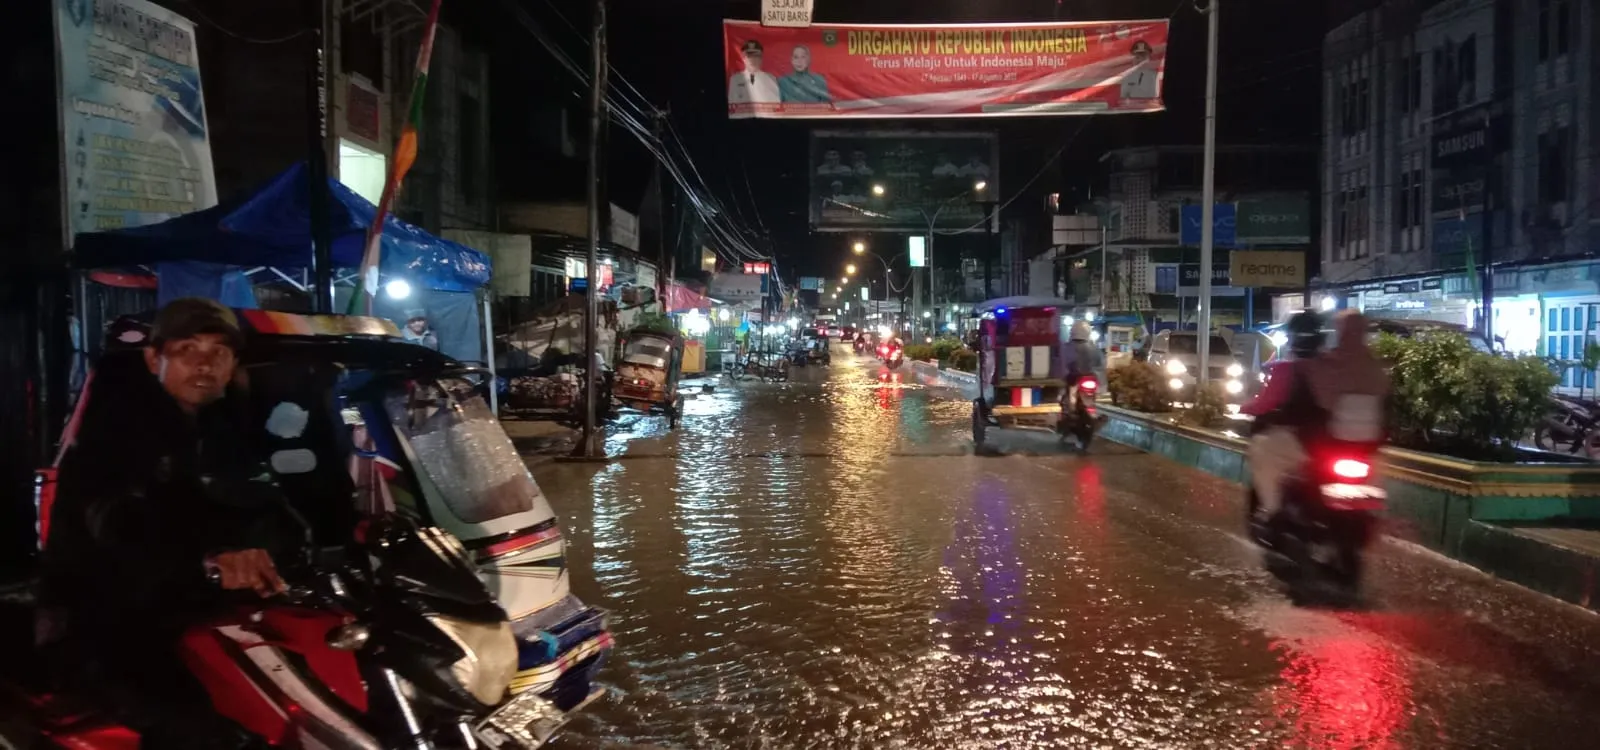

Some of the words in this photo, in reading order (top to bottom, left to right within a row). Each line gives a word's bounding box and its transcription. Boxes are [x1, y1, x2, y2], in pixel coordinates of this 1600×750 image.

[772, 0, 805, 8] SEJAJAR
[768, 10, 785, 21] SATU
[787, 11, 808, 22] BARIS
[848, 29, 930, 55] DIRGAHAYU
[935, 29, 1006, 54] REPUBLIK
[1010, 28, 1088, 54] INDONESIA
[903, 56, 941, 70] Melaju
[944, 56, 977, 68] Untuk
[981, 55, 1033, 67] Indonesia
[1438, 129, 1485, 157] SAMSUN
[1240, 263, 1296, 276] realme
